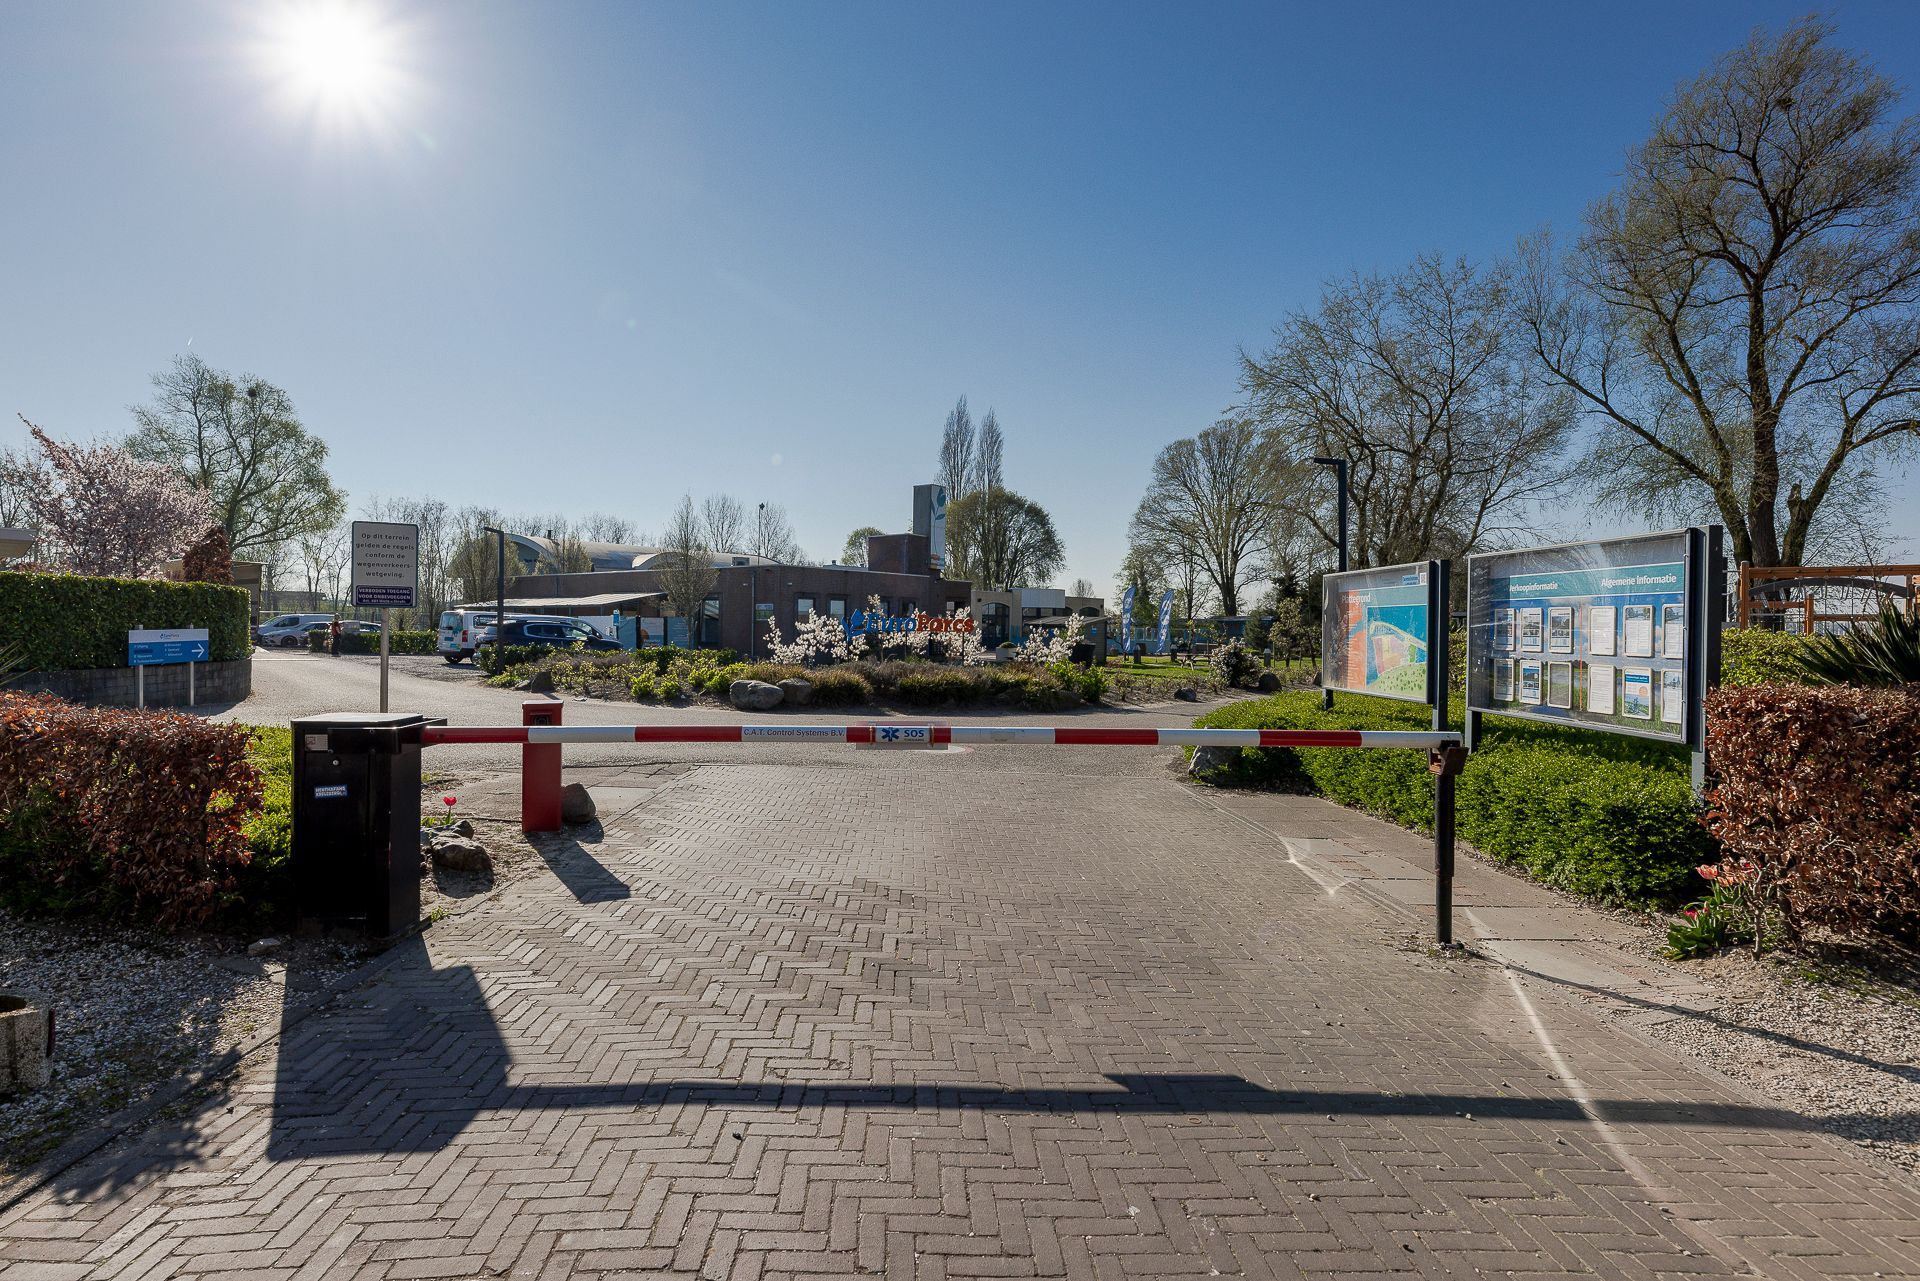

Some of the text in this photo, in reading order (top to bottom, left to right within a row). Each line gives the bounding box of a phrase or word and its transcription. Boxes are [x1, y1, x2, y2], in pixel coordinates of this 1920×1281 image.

[1601, 578, 1636, 589] Algemene
[866, 613, 975, 634] EuroParcs
[743, 728, 845, 737] C.A.T. Control Systems B.V.
[904, 729, 925, 738] SOS
